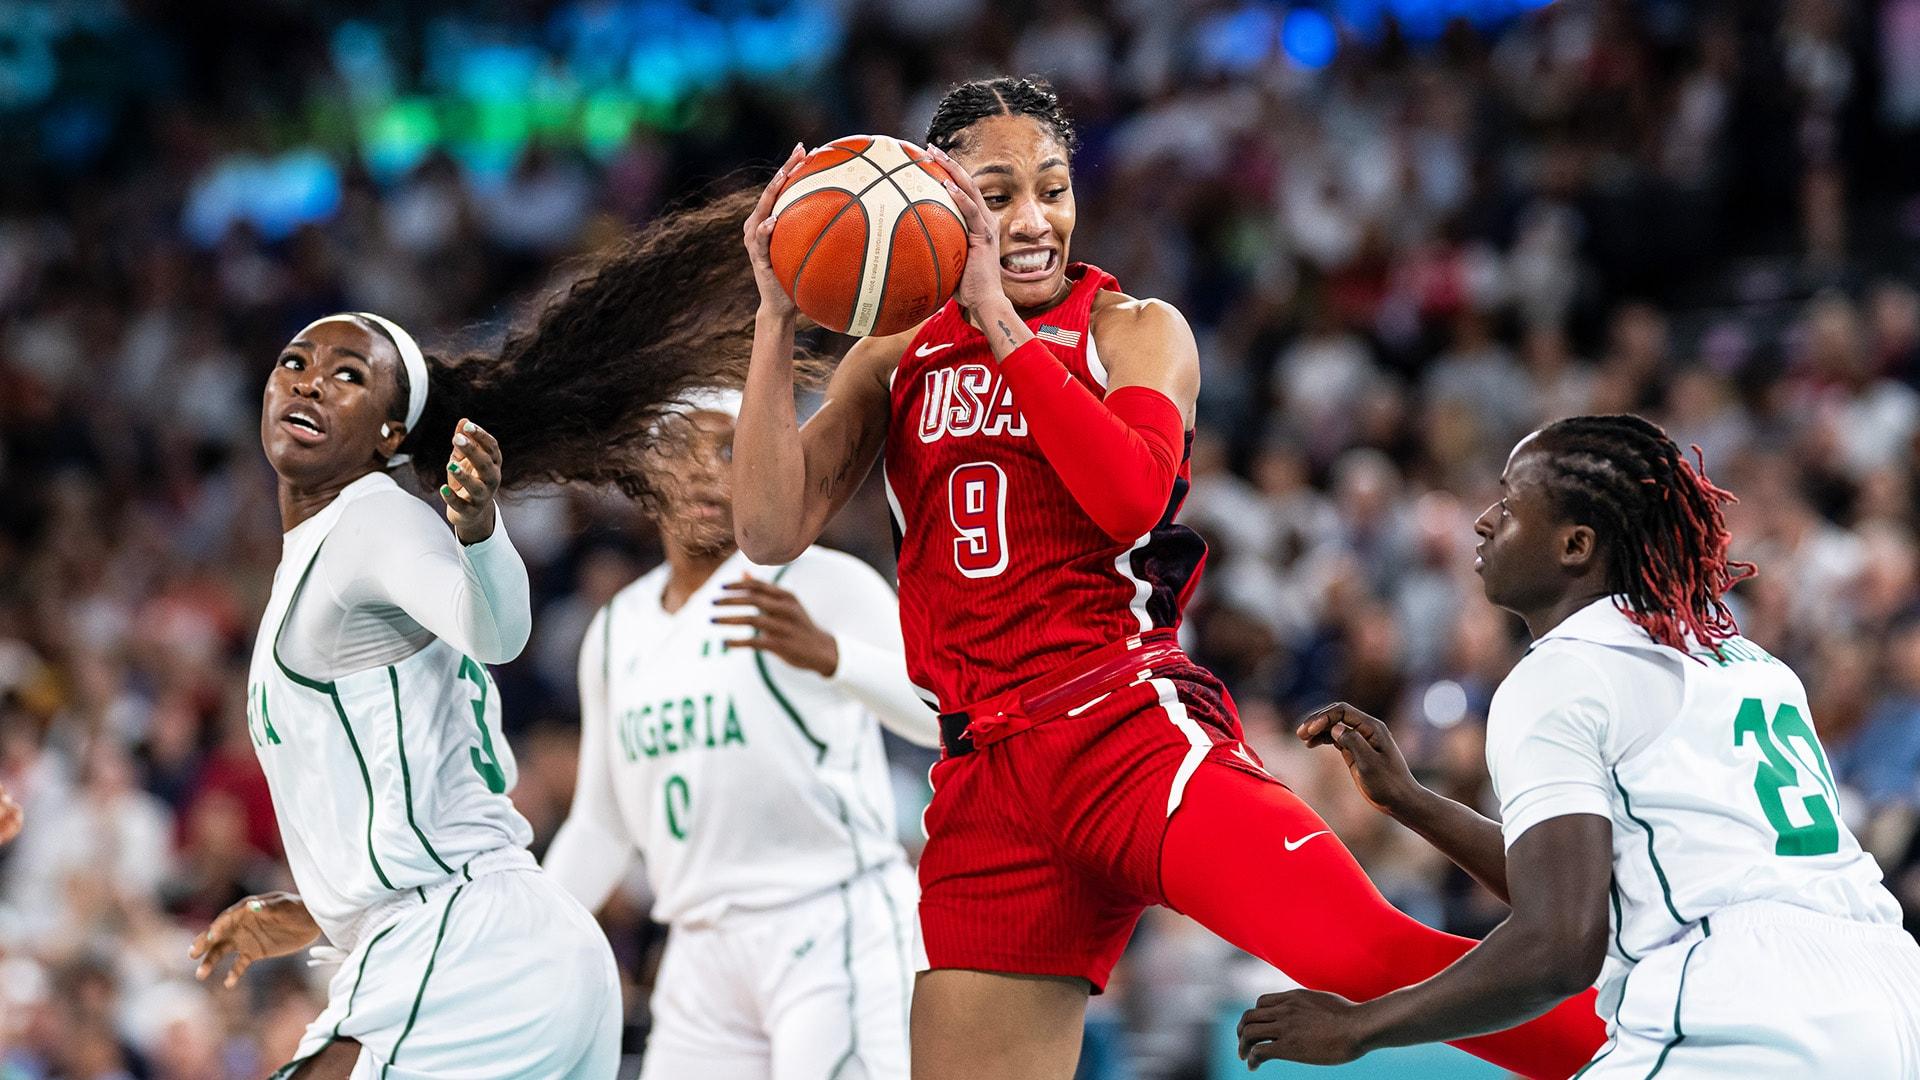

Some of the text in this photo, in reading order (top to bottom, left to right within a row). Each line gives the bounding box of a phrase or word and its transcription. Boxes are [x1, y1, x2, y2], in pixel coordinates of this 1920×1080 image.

[918, 363, 1028, 444] USA
[948, 460, 1010, 579] 9
[665, 774, 691, 841] 0
[1733, 697, 1841, 857] 20
